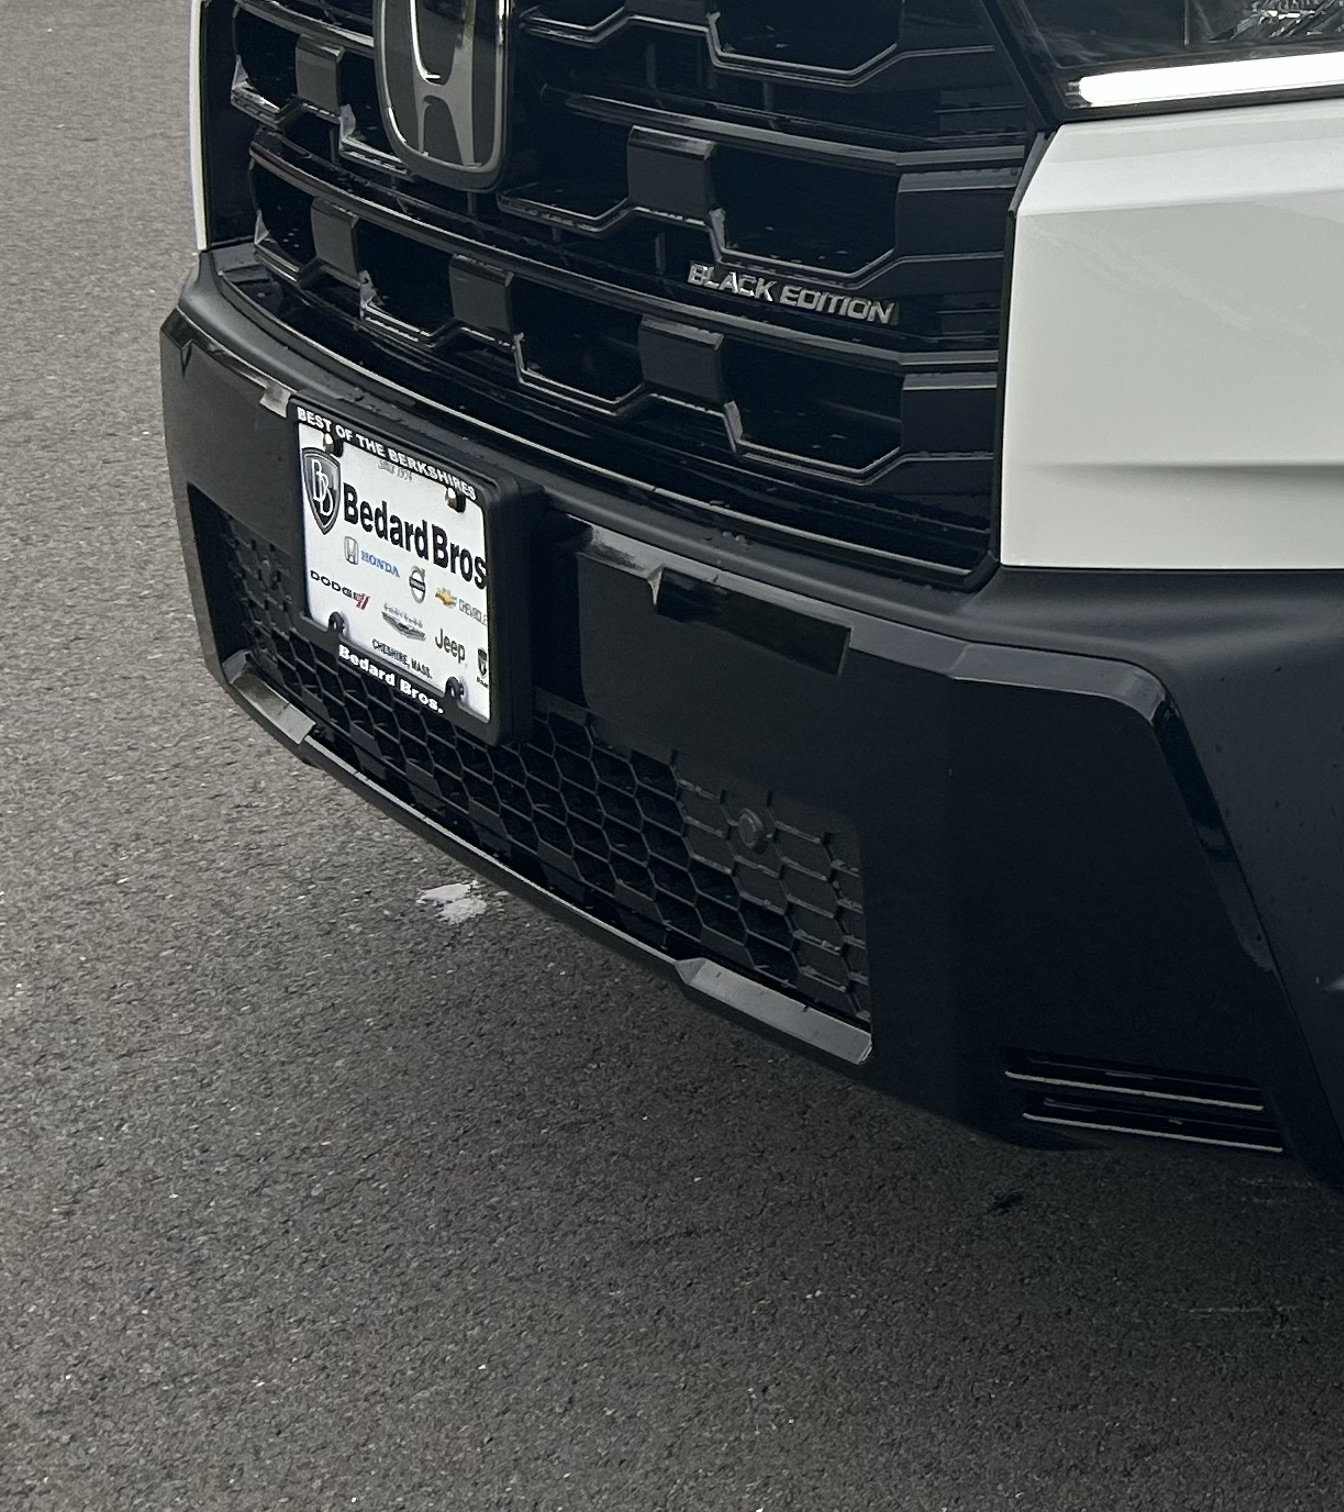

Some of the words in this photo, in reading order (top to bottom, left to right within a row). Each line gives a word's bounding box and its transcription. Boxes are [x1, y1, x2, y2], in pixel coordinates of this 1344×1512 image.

[688, 263, 777, 302] BLACK
[780, 285, 896, 325] EDITION
[297, 406, 332, 433] BEST
[335, 424, 353, 442] OF
[355, 433, 385, 456] THE
[388, 451, 478, 501] BERKSHIRES
[343, 482, 430, 561] Bedard
[431, 523, 488, 590] Bros
[360, 550, 400, 578] HONDA
[310, 569, 364, 602] DODGE
[435, 628, 466, 664] Jeep
[338, 644, 396, 687] Bedard
[400, 678, 445, 715] Bros.
